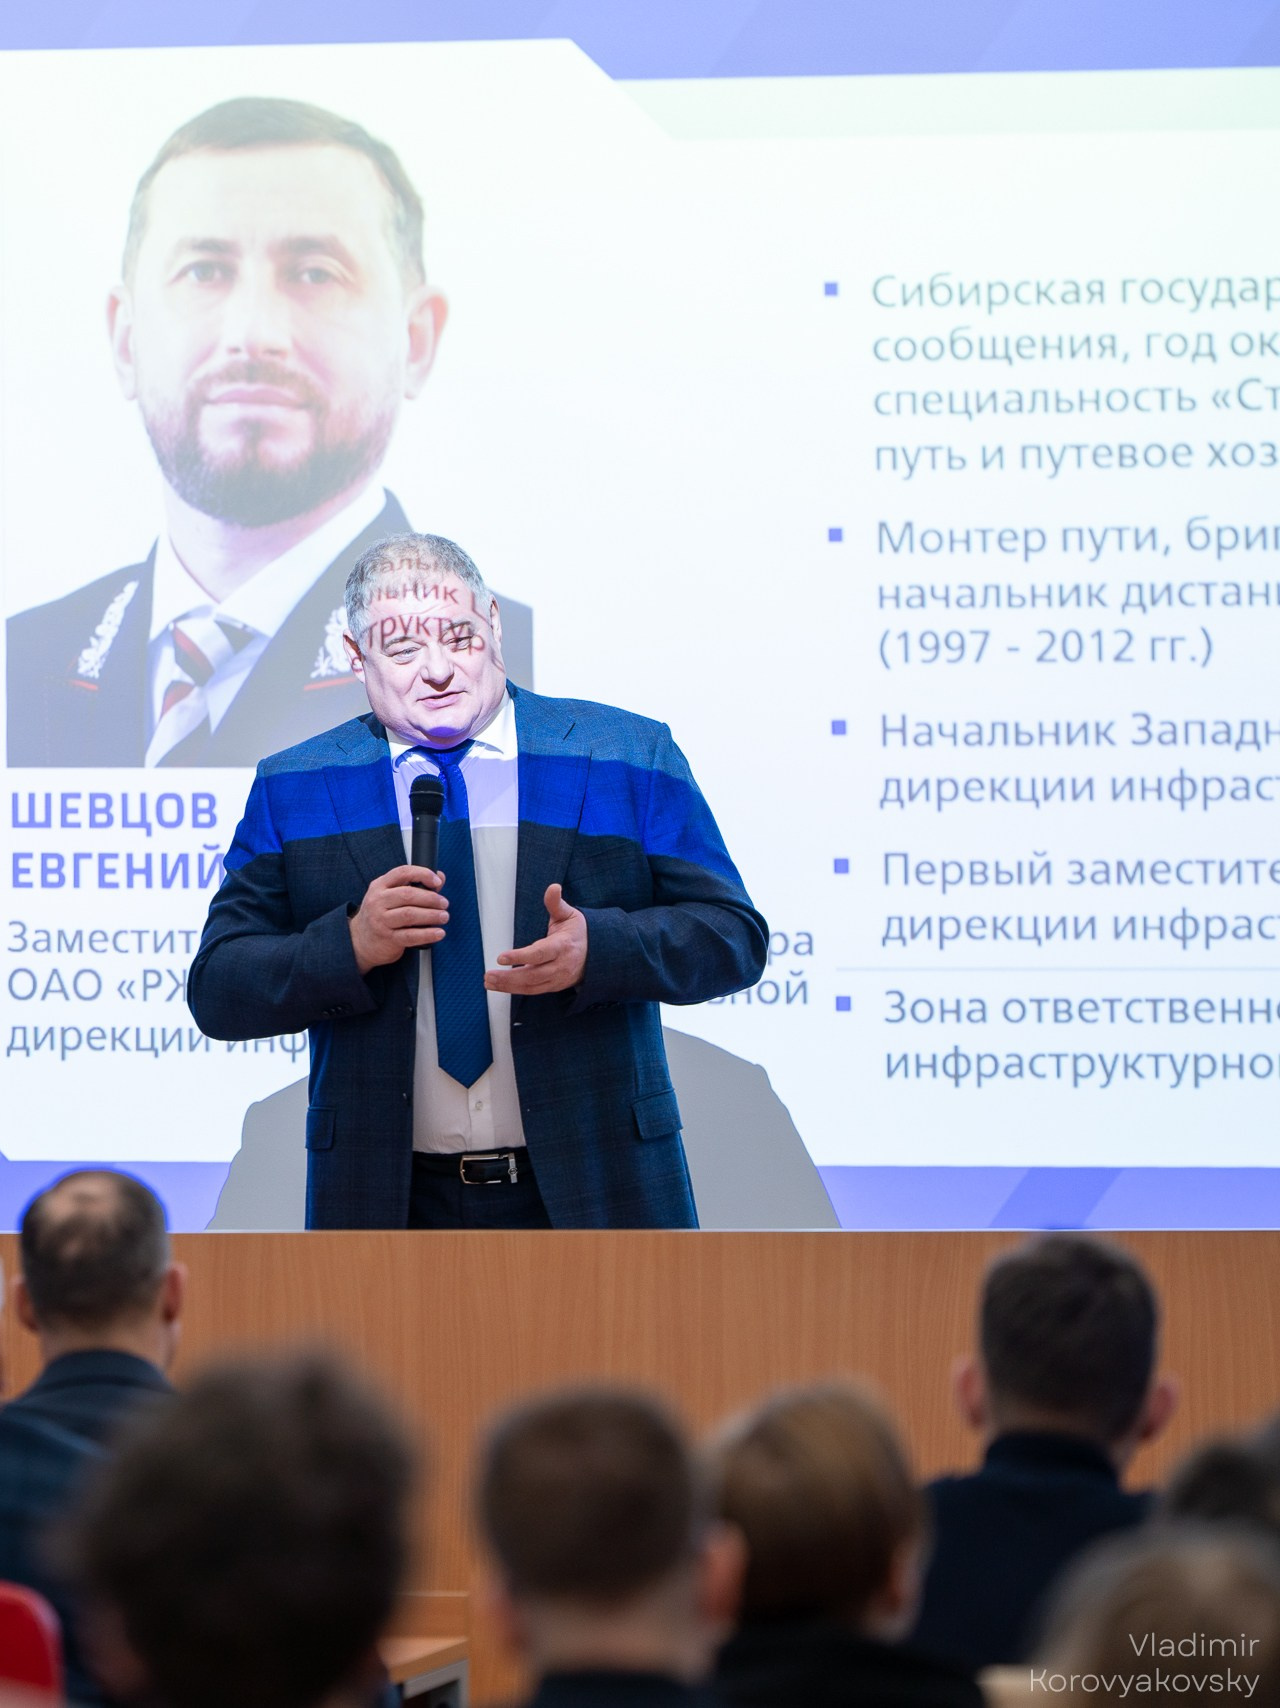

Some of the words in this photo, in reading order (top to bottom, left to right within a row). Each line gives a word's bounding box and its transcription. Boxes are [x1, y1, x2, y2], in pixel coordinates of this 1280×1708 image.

[871, 271, 1105, 316] Сибирская
[1121, 276, 1280, 314] государ
[872, 325, 1130, 367] сообщения,
[1145, 331, 1219, 364] год
[1229, 331, 1280, 358] ок
[873, 387, 1198, 422] специальность
[1211, 376, 1280, 412] «Ст
[875, 445, 968, 481] путь
[981, 445, 1005, 470] и
[1020, 442, 1194, 479] путевое
[1207, 441, 1279, 468] хоз
[877, 520, 1047, 563] Монтер
[1061, 526, 1171, 563] пути,
[878, 582, 1108, 609] начальник
[1120, 581, 1280, 615] дистан
[879, 629, 991, 671] (1997
[1035, 628, 1134, 663] 2012
[1150, 626, 1214, 669] гг.)
[881, 713, 1117, 748] Начальник
[1131, 711, 1280, 753] Западн
[879, 776, 1095, 813] дирекции
[1111, 767, 1280, 812] инфрас
[11, 791, 218, 838] ШЕВЦОВ
[12, 843, 224, 889] ЕВГЕНИЙ
[883, 850, 1053, 896] Первый
[7, 920, 198, 954] Заместит
[881, 915, 1097, 951] дирекции
[1113, 906, 1280, 951] инфрас
[7, 967, 103, 1002] ОАО
[884, 989, 988, 1024] Зона
[1002, 997, 1280, 1025] ответственн
[886, 1044, 1280, 1089] инфраструктурно
